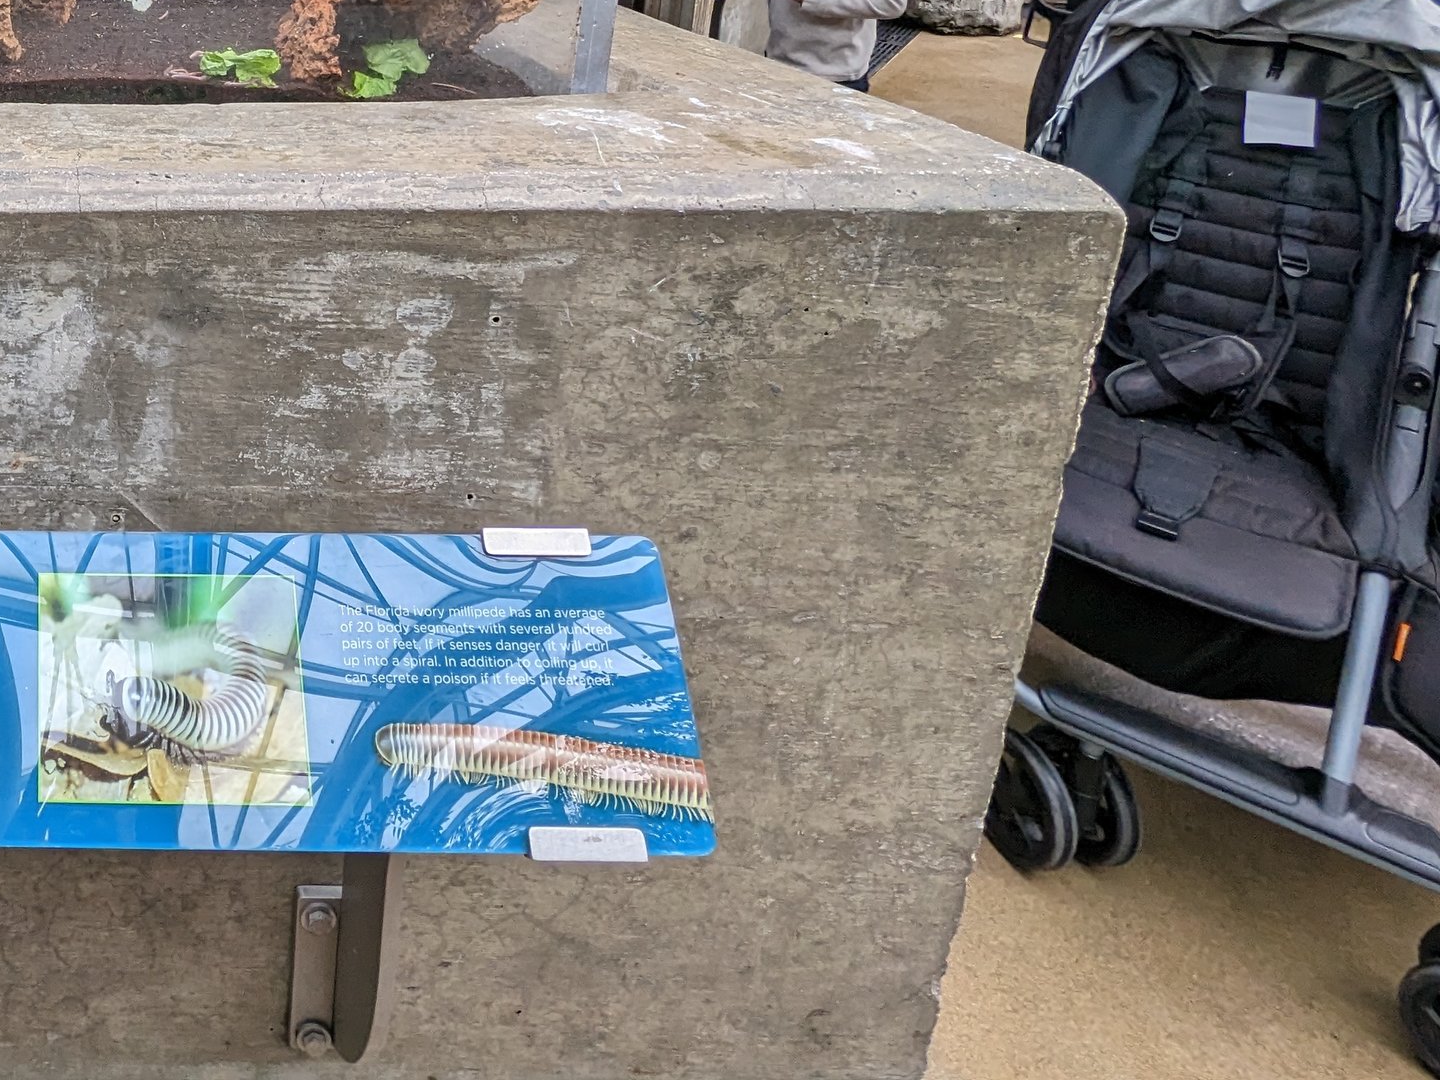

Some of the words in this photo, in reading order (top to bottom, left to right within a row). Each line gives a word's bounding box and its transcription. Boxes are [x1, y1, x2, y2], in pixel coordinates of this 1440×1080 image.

[339, 604, 362, 616] The
[366, 605, 409, 617] Florida
[414, 606, 444, 618] ivory
[449, 606, 506, 618] millipede
[509, 606, 532, 618] has
[535, 609, 551, 618] an
[554, 609, 606, 620] average
[340, 621, 353, 633] of
[357, 621, 373, 633] 20
[378, 622, 409, 635] body
[414, 623, 475, 635] segments
[478, 622, 506, 634] with
[510, 623, 555, 635] several
[559, 623, 612, 635] hundred
[342, 638, 373, 650] pairs
[376, 638, 389, 649] of
[393, 638, 422, 650] feet.
[425, 638, 434, 649] If
[437, 638, 446, 650] it
[449, 640, 492, 651] senses
[548, 639, 556, 651] it
[560, 639, 581, 651] will
[585, 640, 609, 651] curl
[343, 657, 360, 668] up
[364, 655, 388, 667] into
[392, 657, 400, 667] a
[403, 655, 441, 668] spiral.
[445, 655, 456, 667] In
[460, 656, 513, 668] addition
[517, 656, 531, 668] to
[534, 657, 577, 670] coiling
[604, 657, 613, 669] it
[345, 673, 368, 683] can
[372, 674, 418, 684] secrete
[423, 675, 430, 684] a
[434, 673, 477, 685] poison
[481, 673, 489, 684] if
[493, 673, 501, 684] it
[505, 673, 536, 684] feels
[540, 673, 614, 686] threatened.
